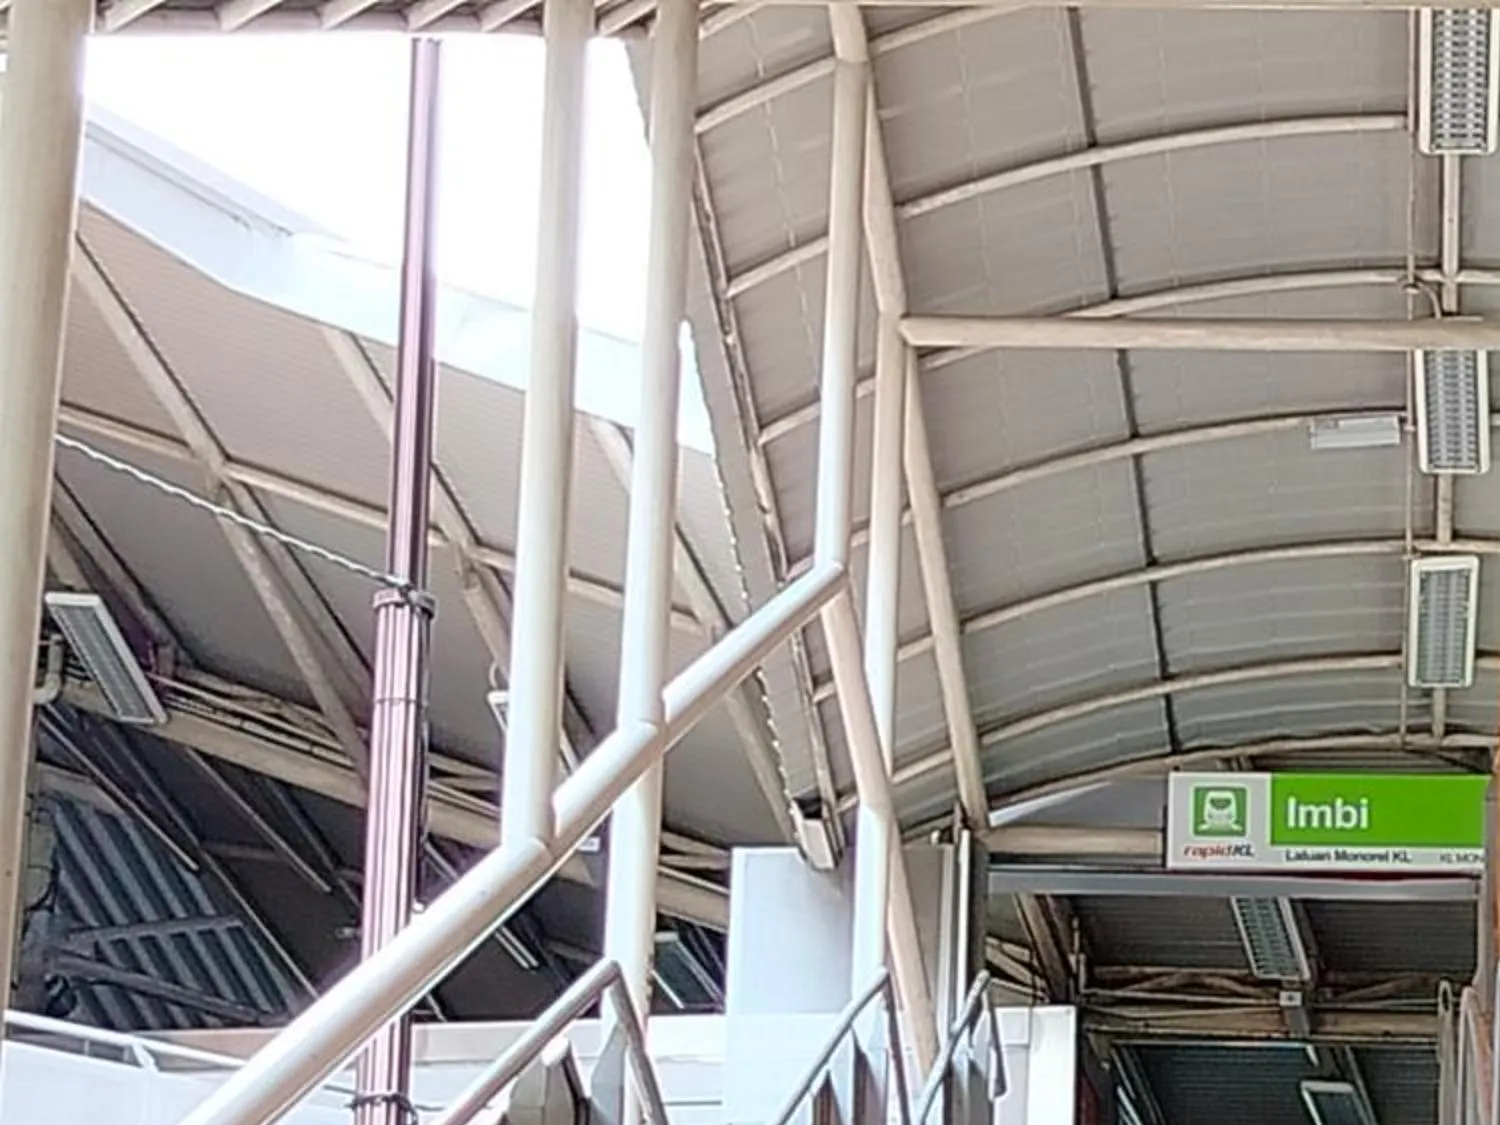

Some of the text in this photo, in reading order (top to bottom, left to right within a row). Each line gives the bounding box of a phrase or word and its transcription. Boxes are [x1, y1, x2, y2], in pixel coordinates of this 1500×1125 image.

[1286, 796, 1369, 829] Imbi
[1285, 848, 1331, 863] Laluan
[1392, 850, 1412, 863] KL
